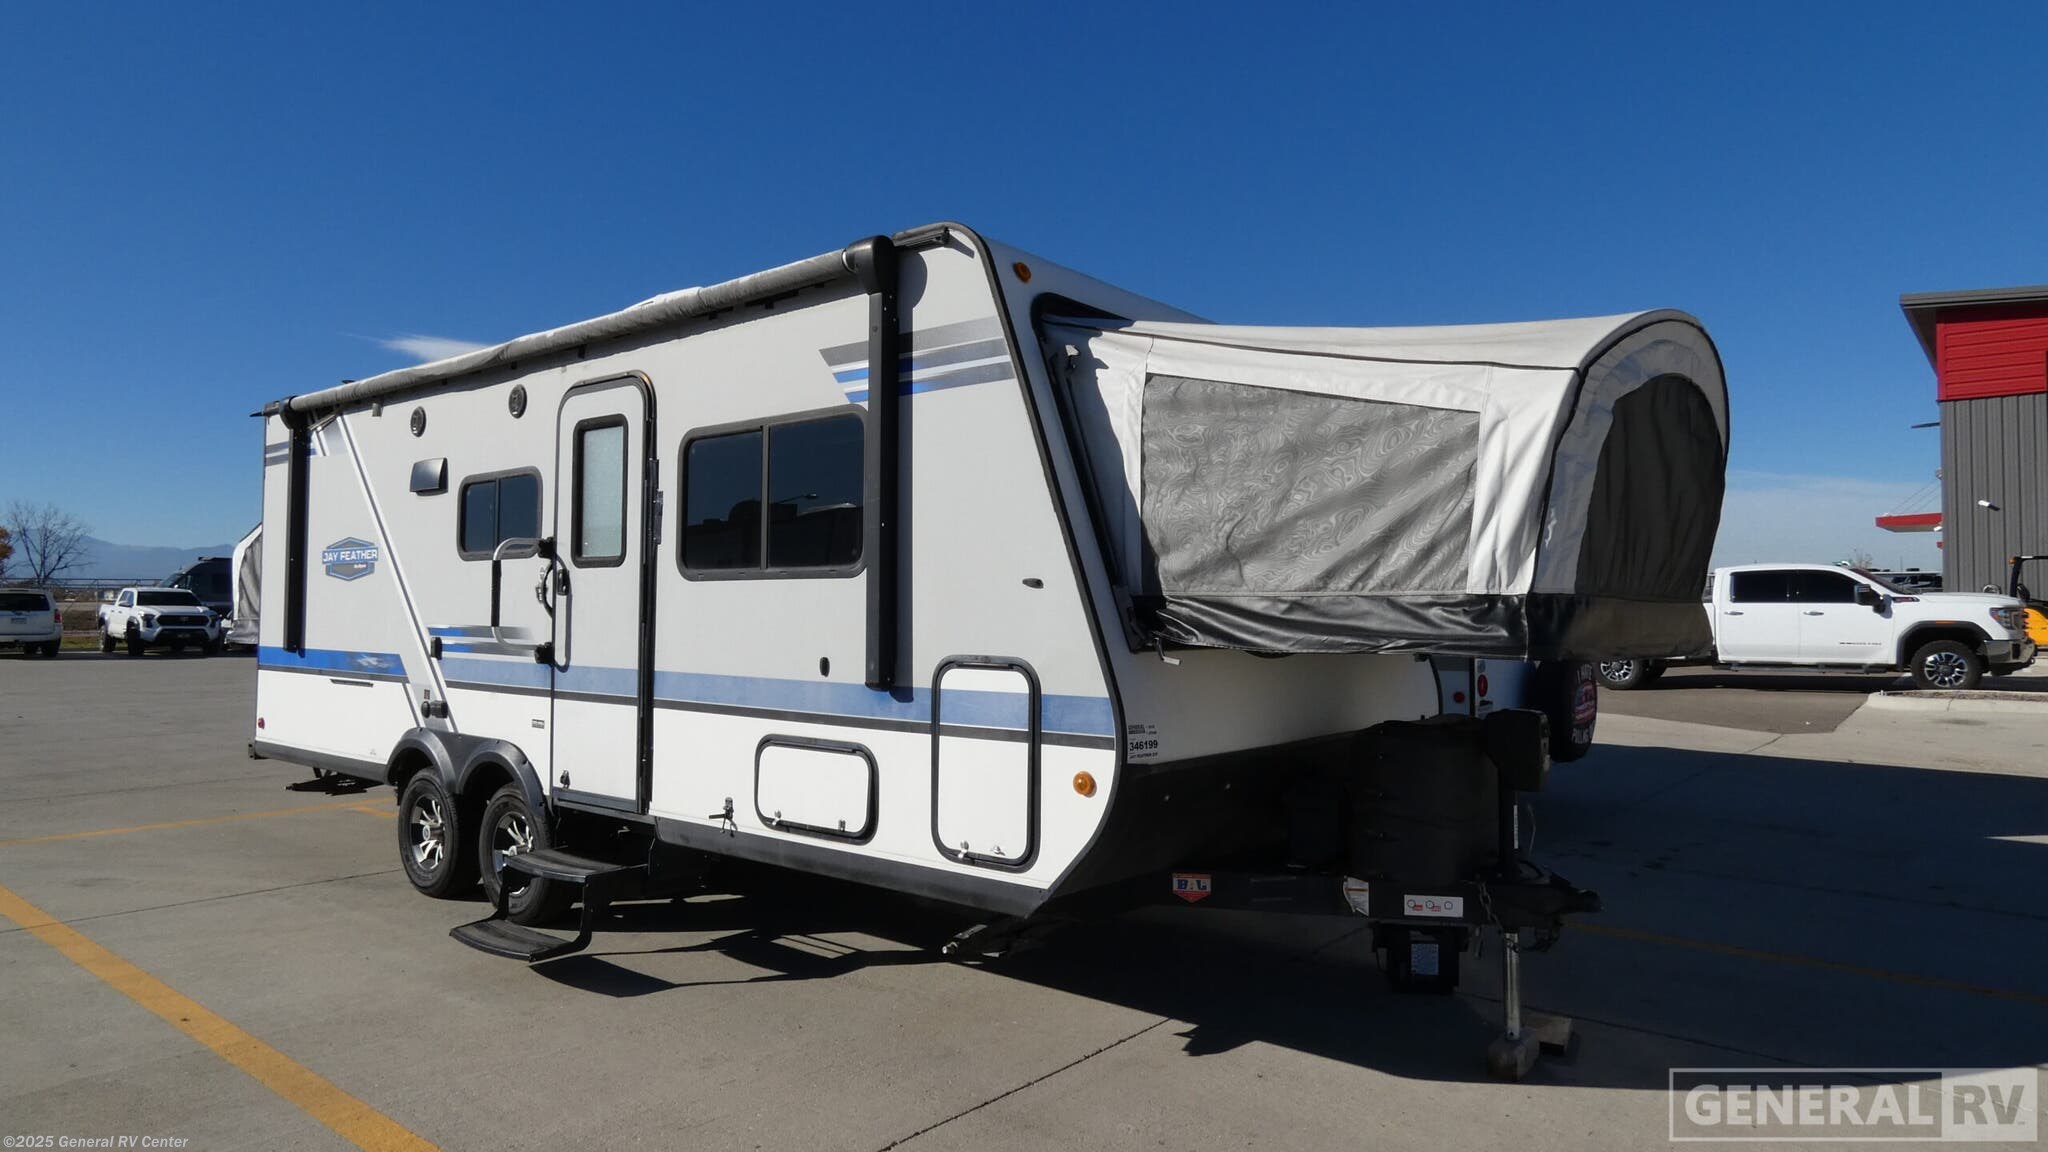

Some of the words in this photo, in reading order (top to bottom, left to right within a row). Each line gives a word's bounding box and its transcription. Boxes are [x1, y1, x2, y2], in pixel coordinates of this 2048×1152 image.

[323, 551, 338, 562] JAY
[340, 549, 378, 561] FEATHER
[1129, 740, 1158, 751] 346199
